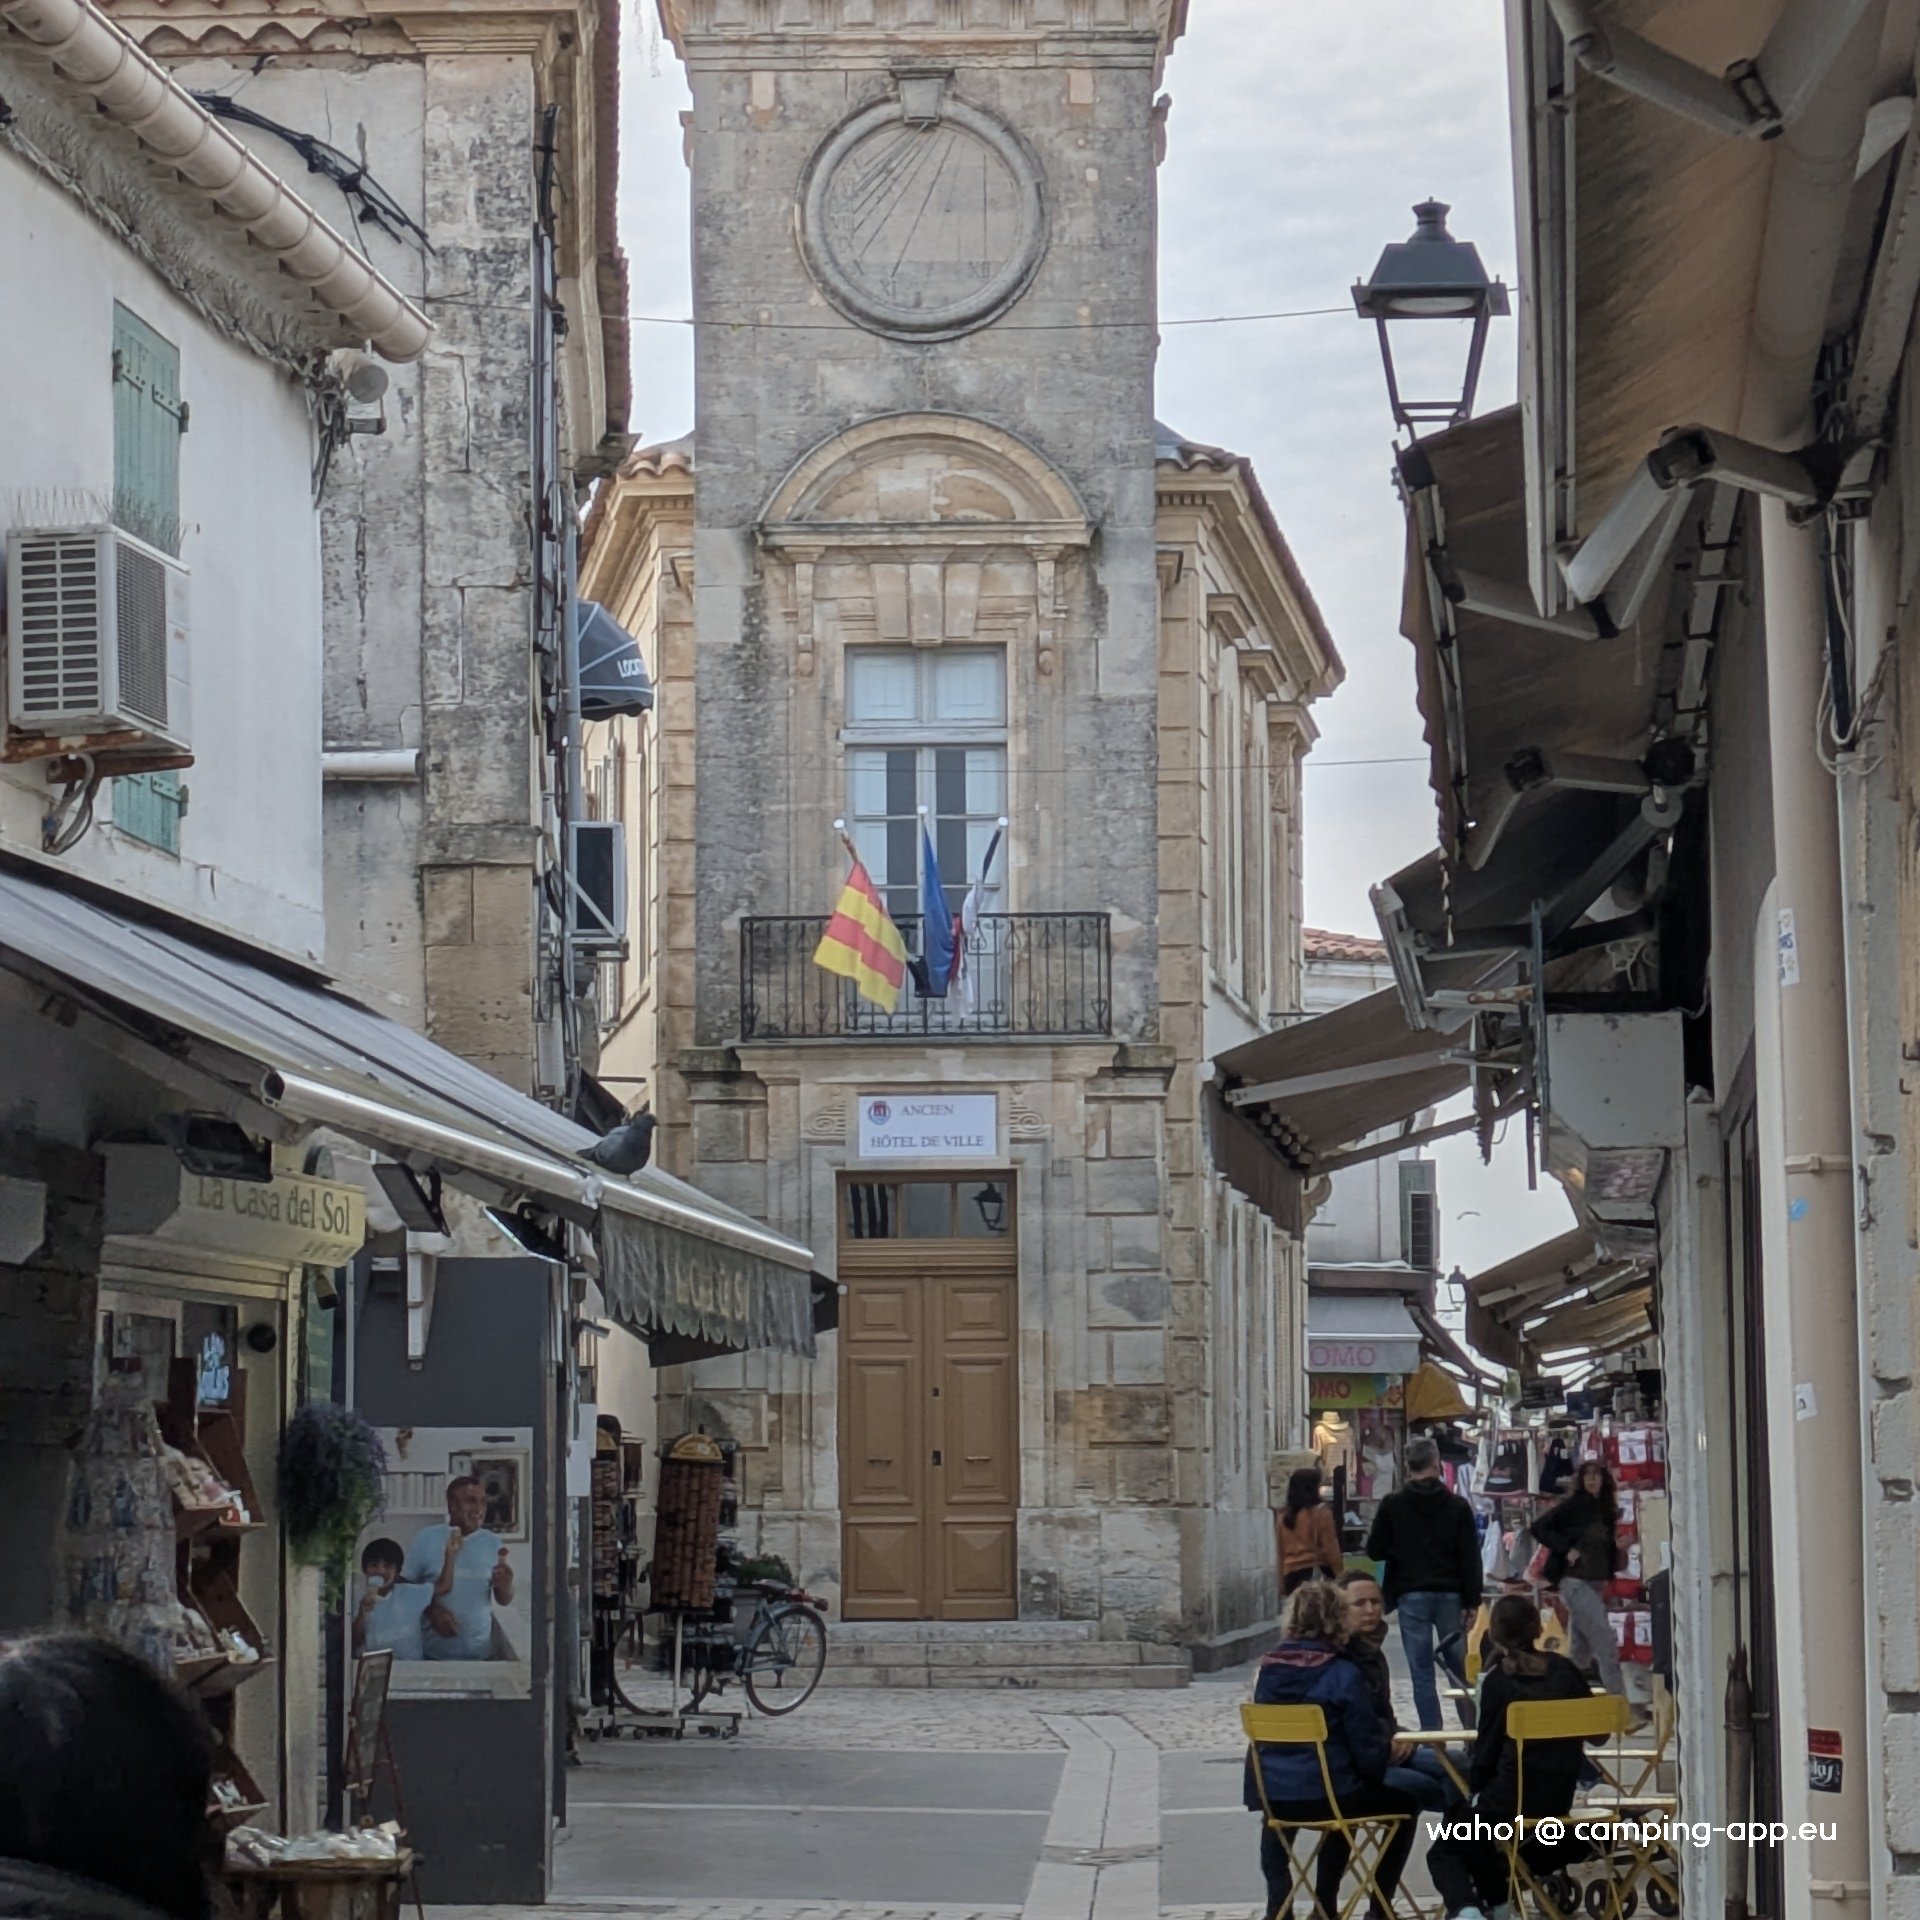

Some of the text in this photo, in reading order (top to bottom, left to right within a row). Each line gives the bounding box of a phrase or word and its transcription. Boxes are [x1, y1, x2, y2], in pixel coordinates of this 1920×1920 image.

[968, 261, 992, 279] XII
[901, 1104, 954, 1116] ANCIEN
[871, 1134, 984, 1148] HÔTEL DE VILLE
[197, 1177, 351, 1236] La Casa del Sol
[1310, 1346, 1376, 1367] OMO
